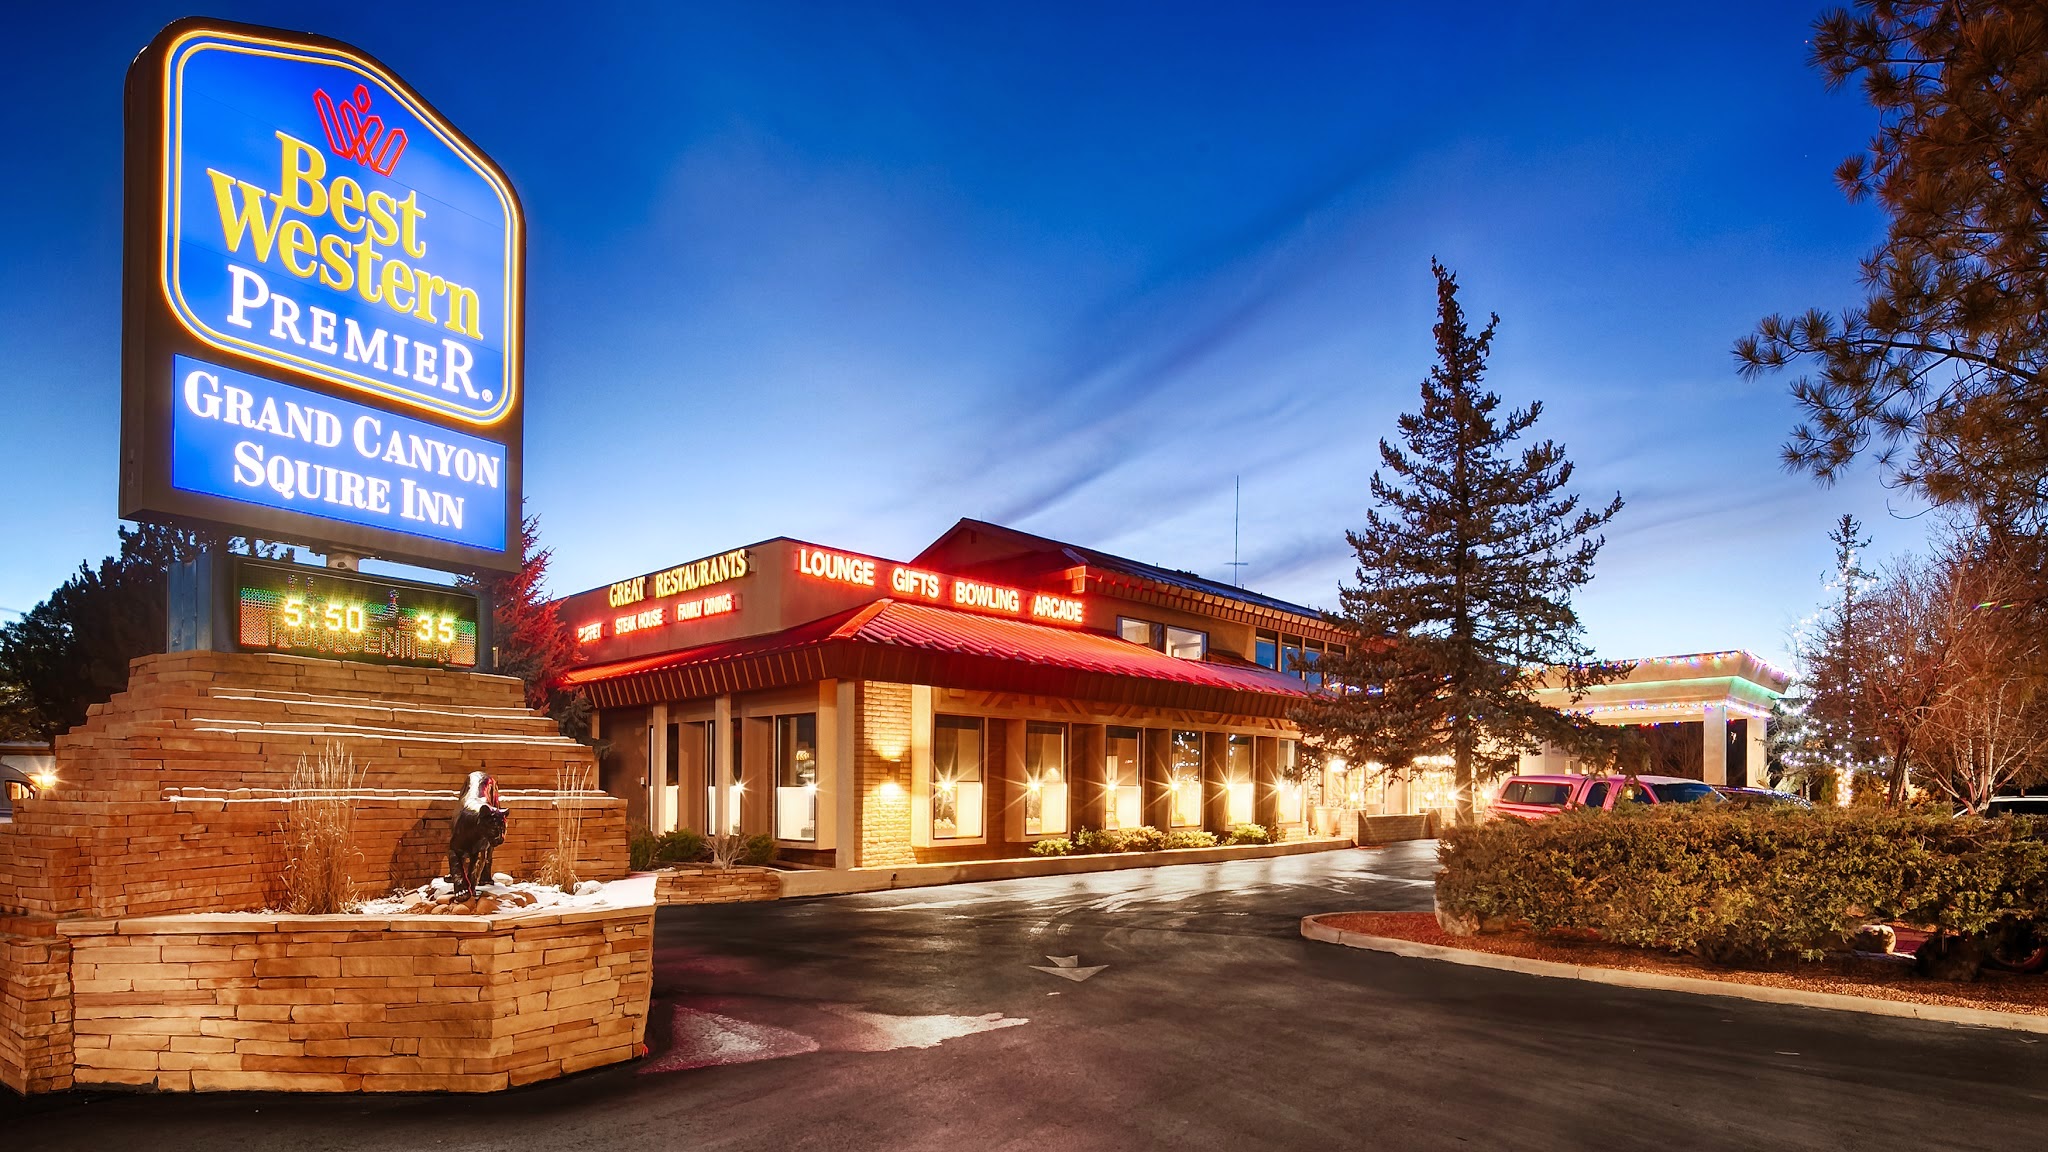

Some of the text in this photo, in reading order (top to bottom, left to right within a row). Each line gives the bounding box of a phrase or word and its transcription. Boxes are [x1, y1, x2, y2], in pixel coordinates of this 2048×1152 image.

[275, 130, 427, 259] Best
[207, 168, 483, 340] Western
[227, 265, 480, 401] PREMIER
[184, 370, 500, 489] GRAND CANYON
[234, 442, 464, 530] SQUIRE INN
[609, 549, 746, 608] GREAT RESTAURANTS
[677, 593, 732, 622] FAMILY DINING
[800, 548, 1083, 622] LOUNGE GIFTS BOWLING ARCADE
[283, 599, 364, 634] 5:50
[416, 615, 454, 643] 35
[615, 608, 663, 635] STEAK HOUSE
